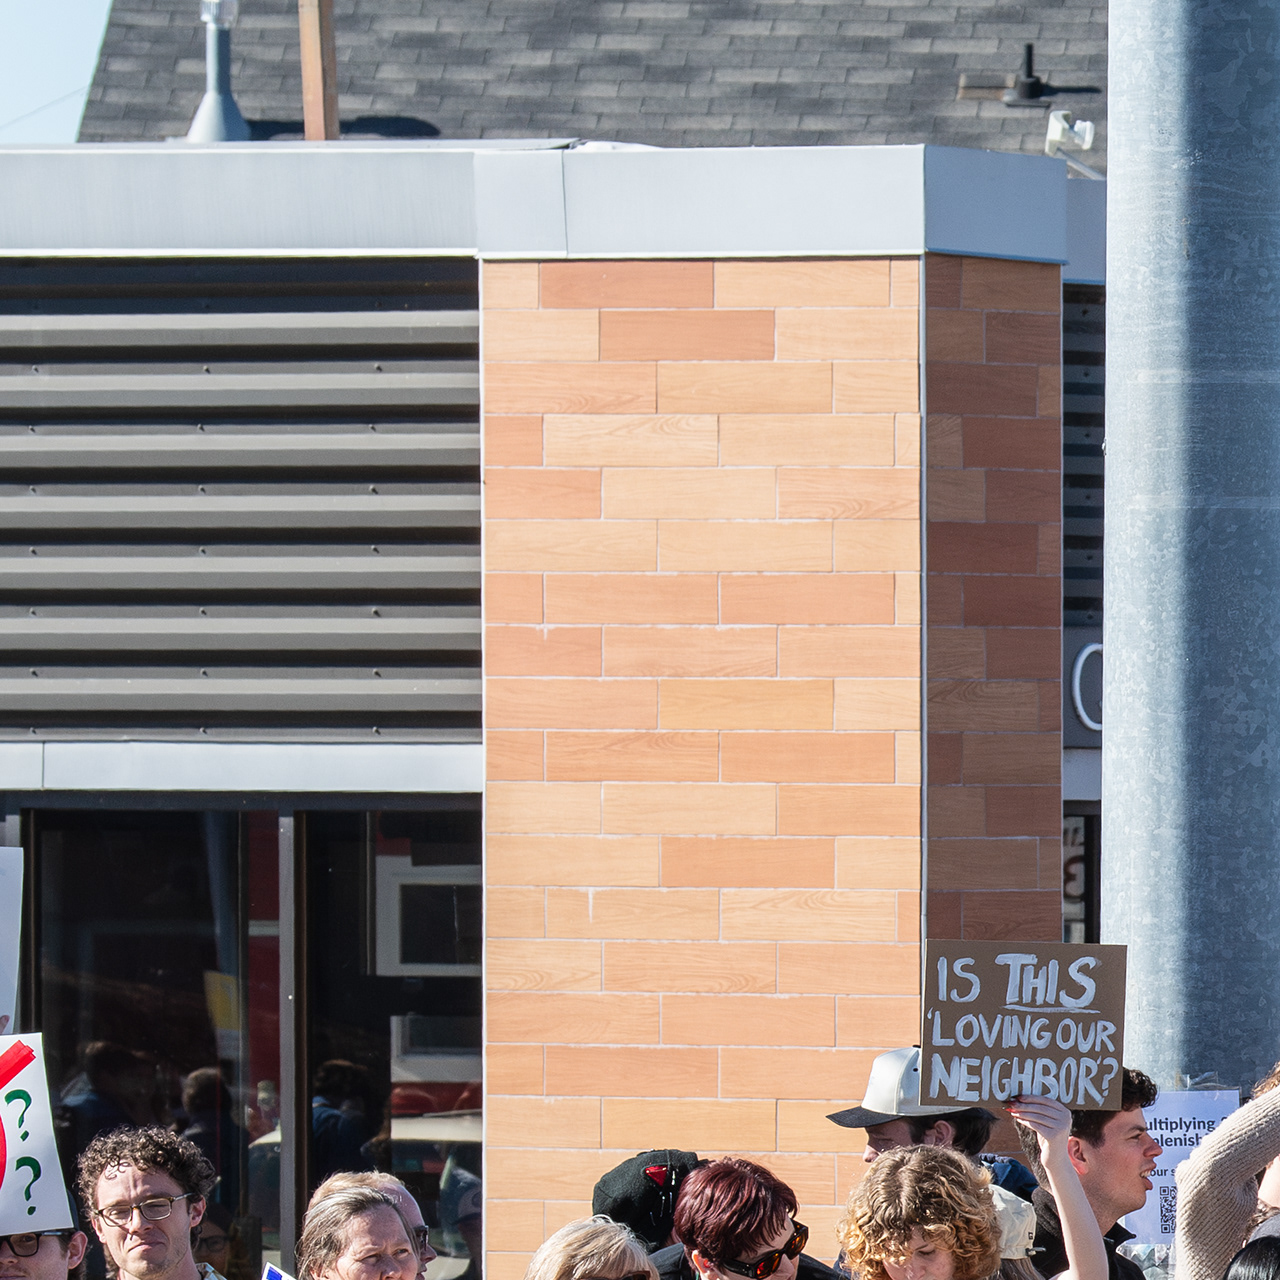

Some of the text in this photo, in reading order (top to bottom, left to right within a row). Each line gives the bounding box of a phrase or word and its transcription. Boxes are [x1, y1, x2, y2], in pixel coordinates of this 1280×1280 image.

[937, 953, 1099, 1009] IS THIS
[1055, 1017, 1117, 1054] OUR
[1145, 1116, 1216, 1133] ultiplying
